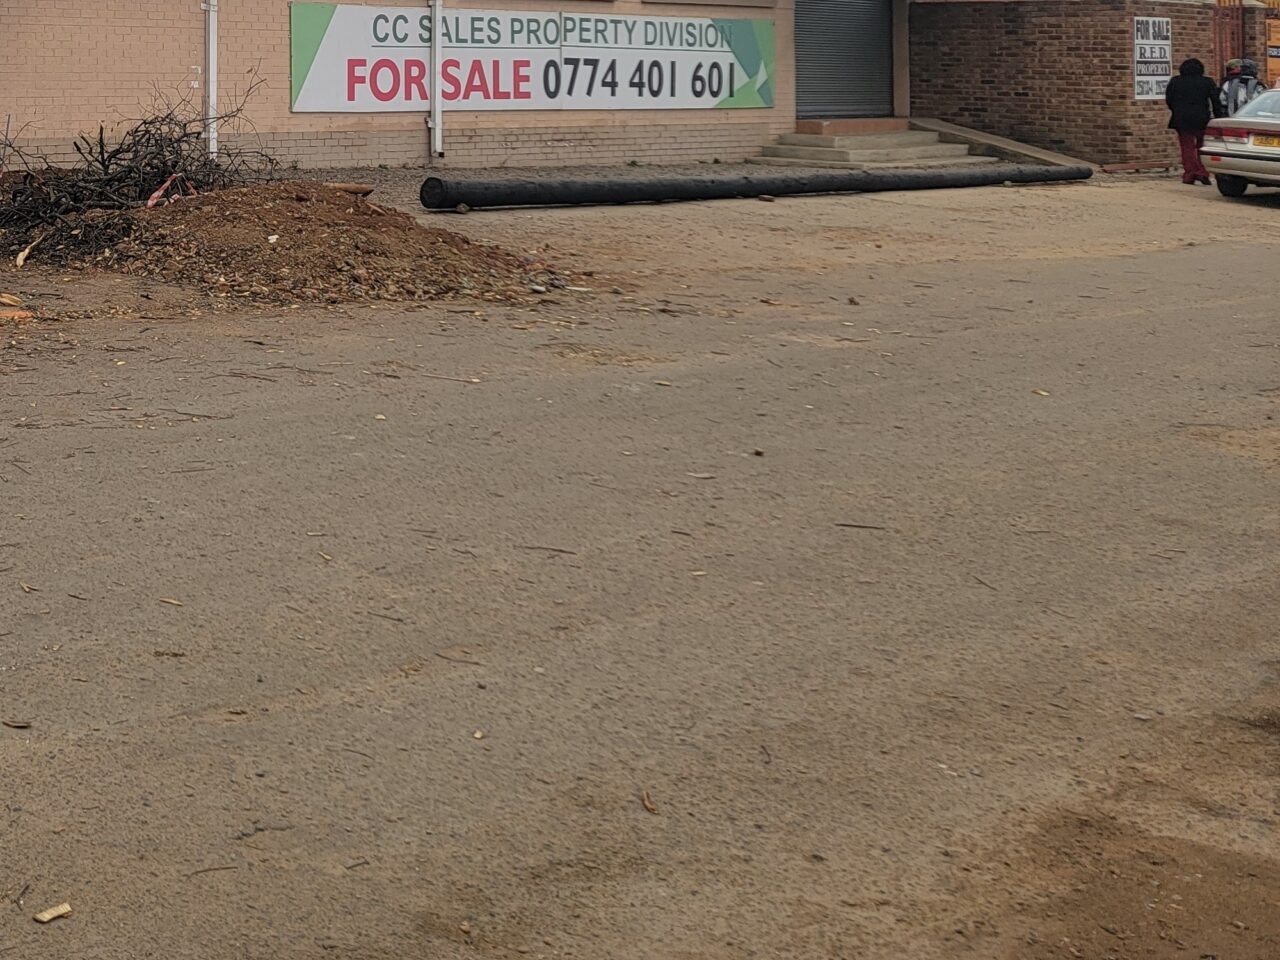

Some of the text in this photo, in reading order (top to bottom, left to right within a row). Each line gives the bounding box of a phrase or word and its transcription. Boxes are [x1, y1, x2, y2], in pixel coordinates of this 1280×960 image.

[372, 14, 735, 49] CC SALES PROPERTY DIVISION
[1136, 19, 1170, 40] FOR SALE
[1139, 46, 1168, 60] R.E.D.
[1137, 63, 1170, 74] PROPERTY
[346, 57, 735, 102] FOR SALE 0774 401 601
